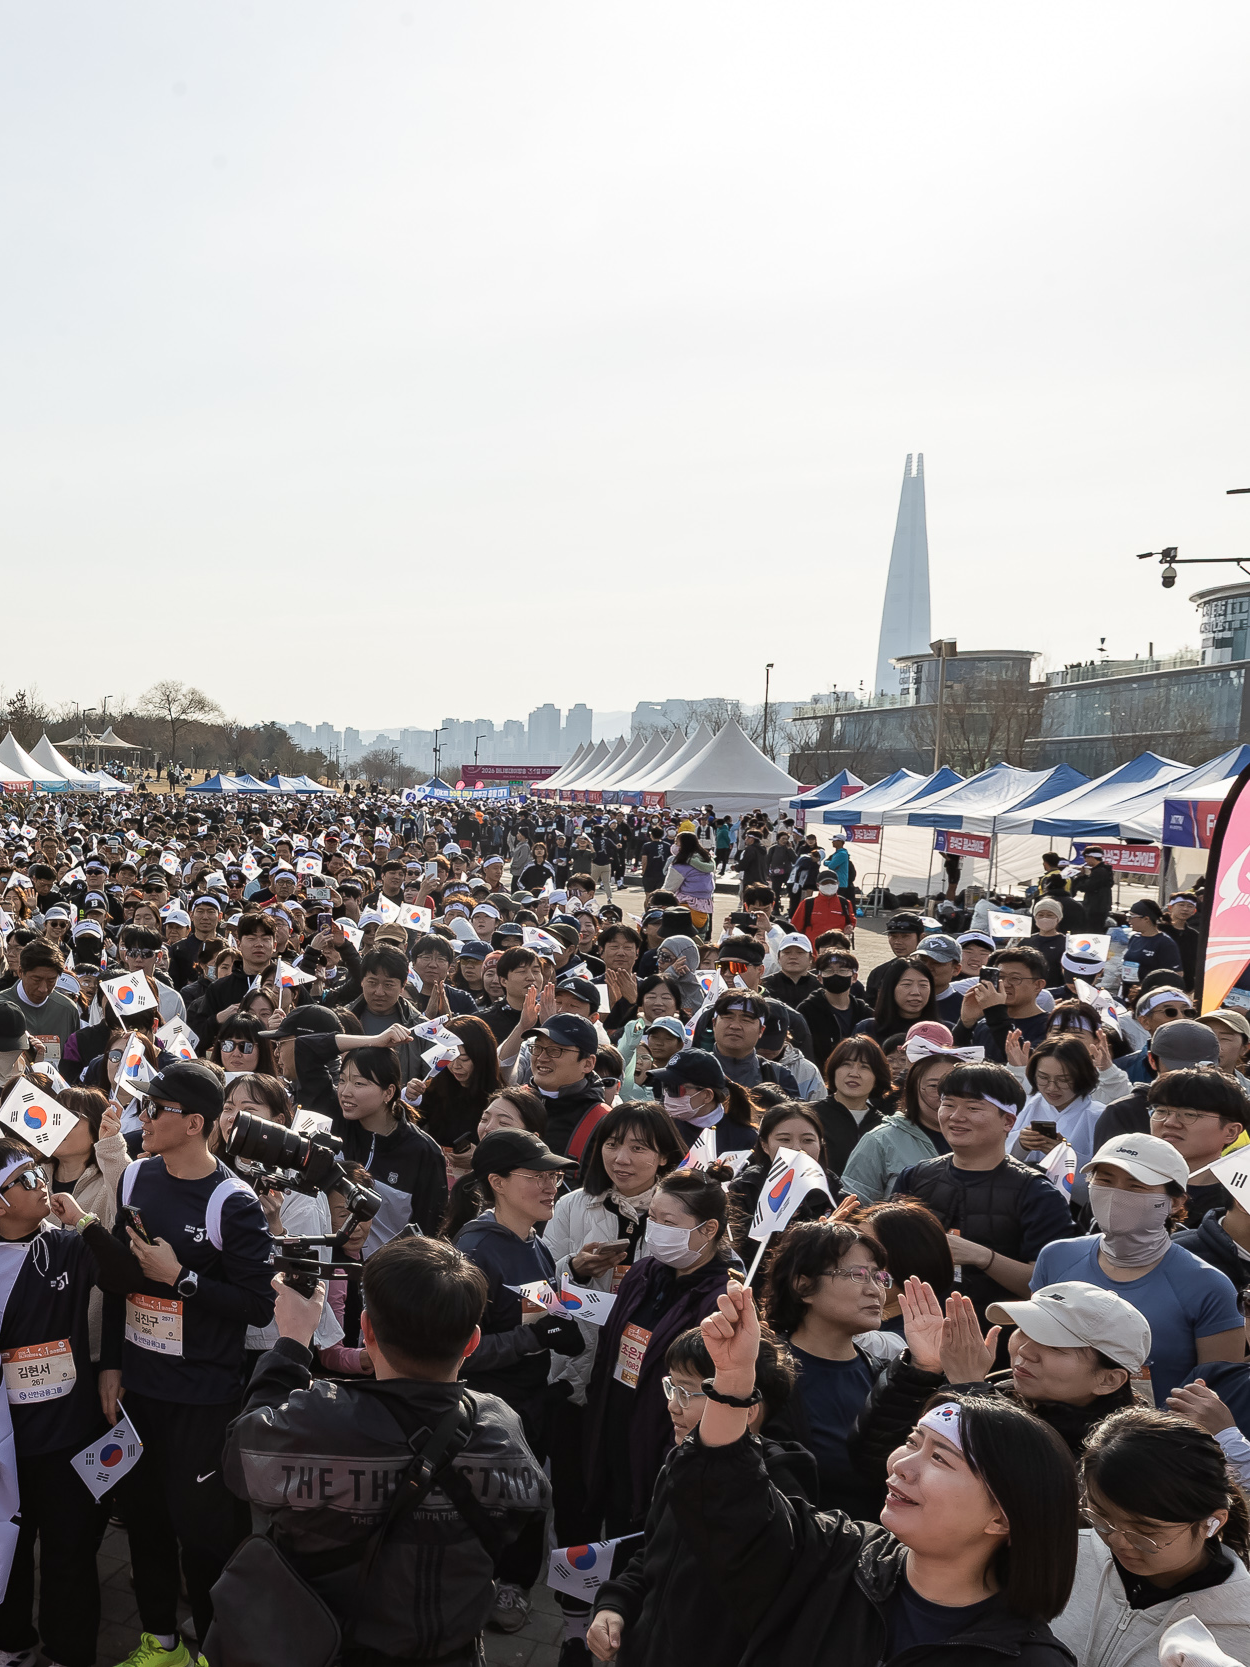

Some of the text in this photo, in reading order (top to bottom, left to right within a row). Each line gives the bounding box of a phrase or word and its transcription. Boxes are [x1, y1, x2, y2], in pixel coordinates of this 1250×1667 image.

[1119, 850, 1156, 868] 헬스라이프
[1116, 1147, 1139, 1157] Jeep
[134, 1311, 159, 1328] 김진구
[161, 1315, 174, 1323] 2571
[137, 1336, 167, 1350] 신한금융그룹
[17, 1363, 51, 1379] 김현서
[625, 1360, 640, 1372] 1082
[31, 1378, 45, 1386] 267
[27, 1387, 63, 1399] 신한금융그룹
[281, 1465, 334, 1500] THE
[351, 1515, 374, 1526] THE
[413, 1511, 440, 1521] WITH
